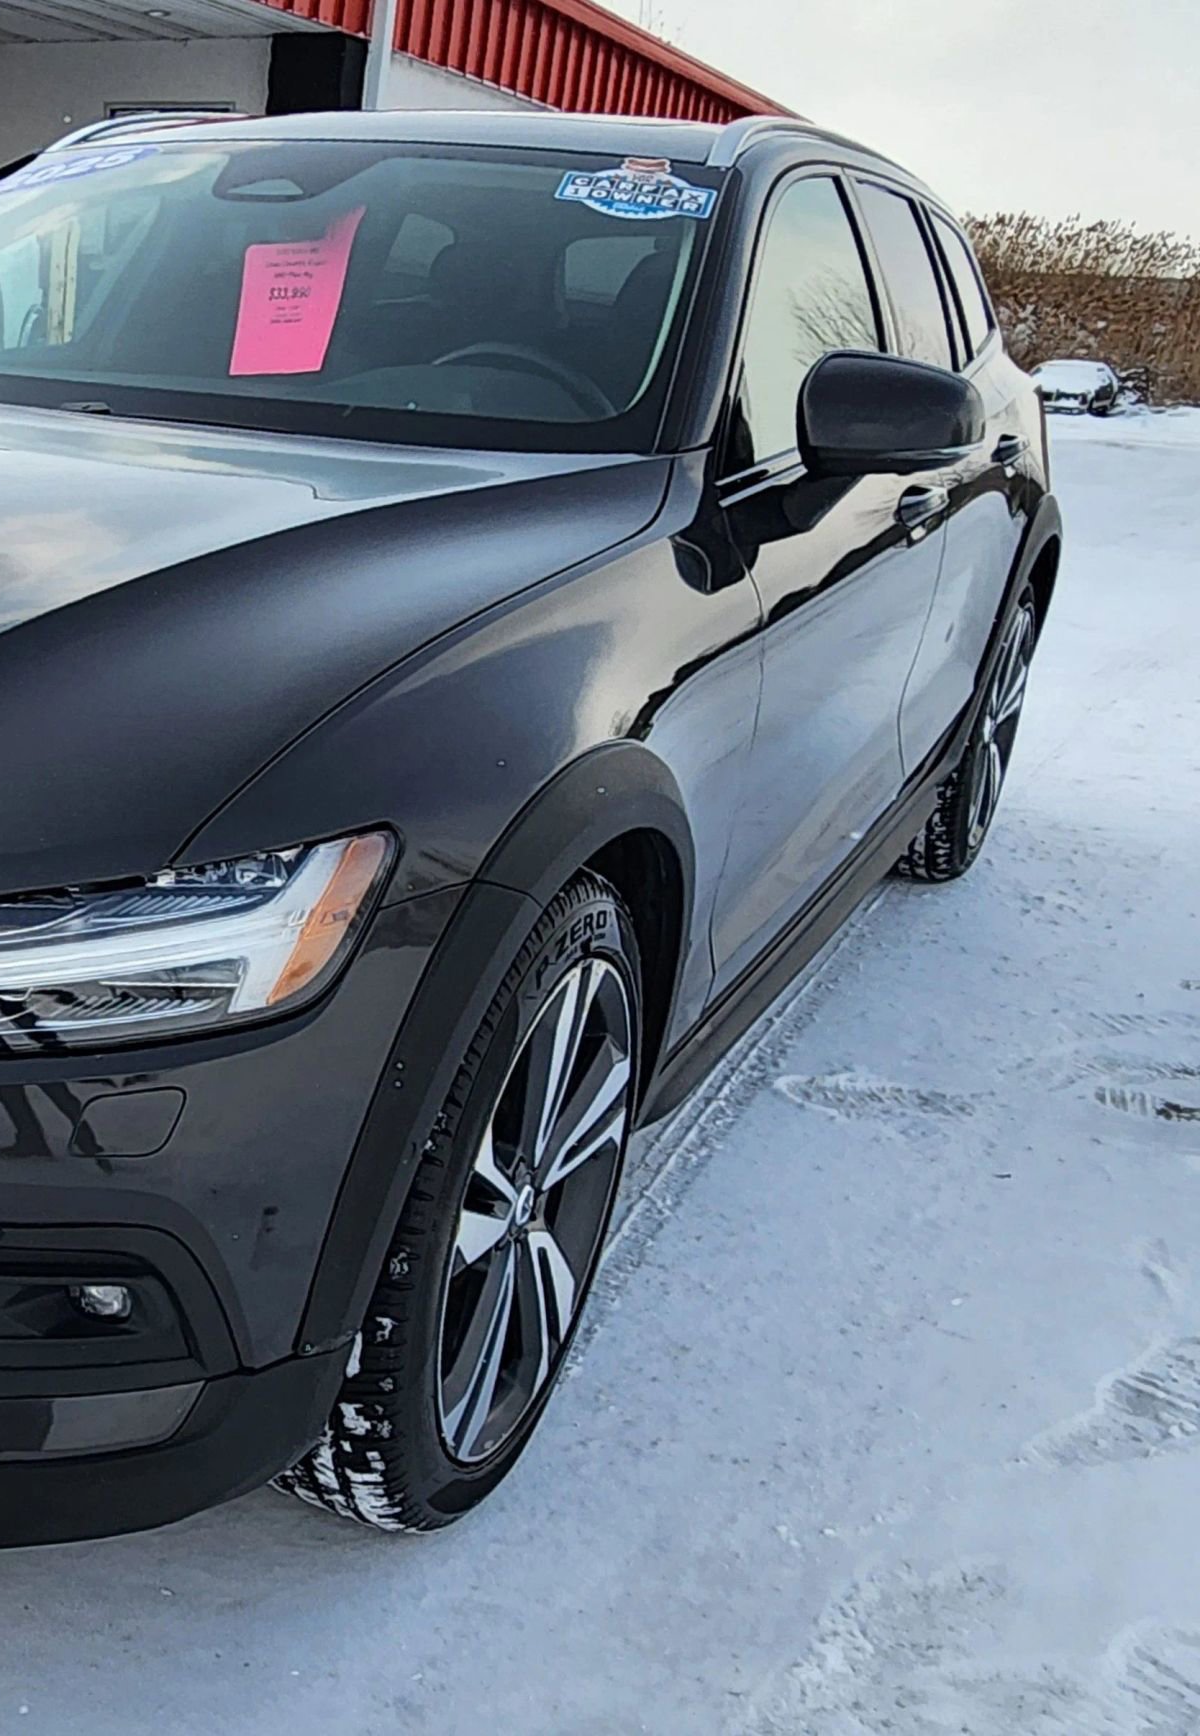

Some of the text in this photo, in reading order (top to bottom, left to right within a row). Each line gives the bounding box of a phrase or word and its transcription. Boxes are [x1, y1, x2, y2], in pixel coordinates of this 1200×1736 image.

[574, 177, 702, 204] CARFAX
[592, 189, 698, 212] OWNER
[554, 909, 608, 962] ZERO
